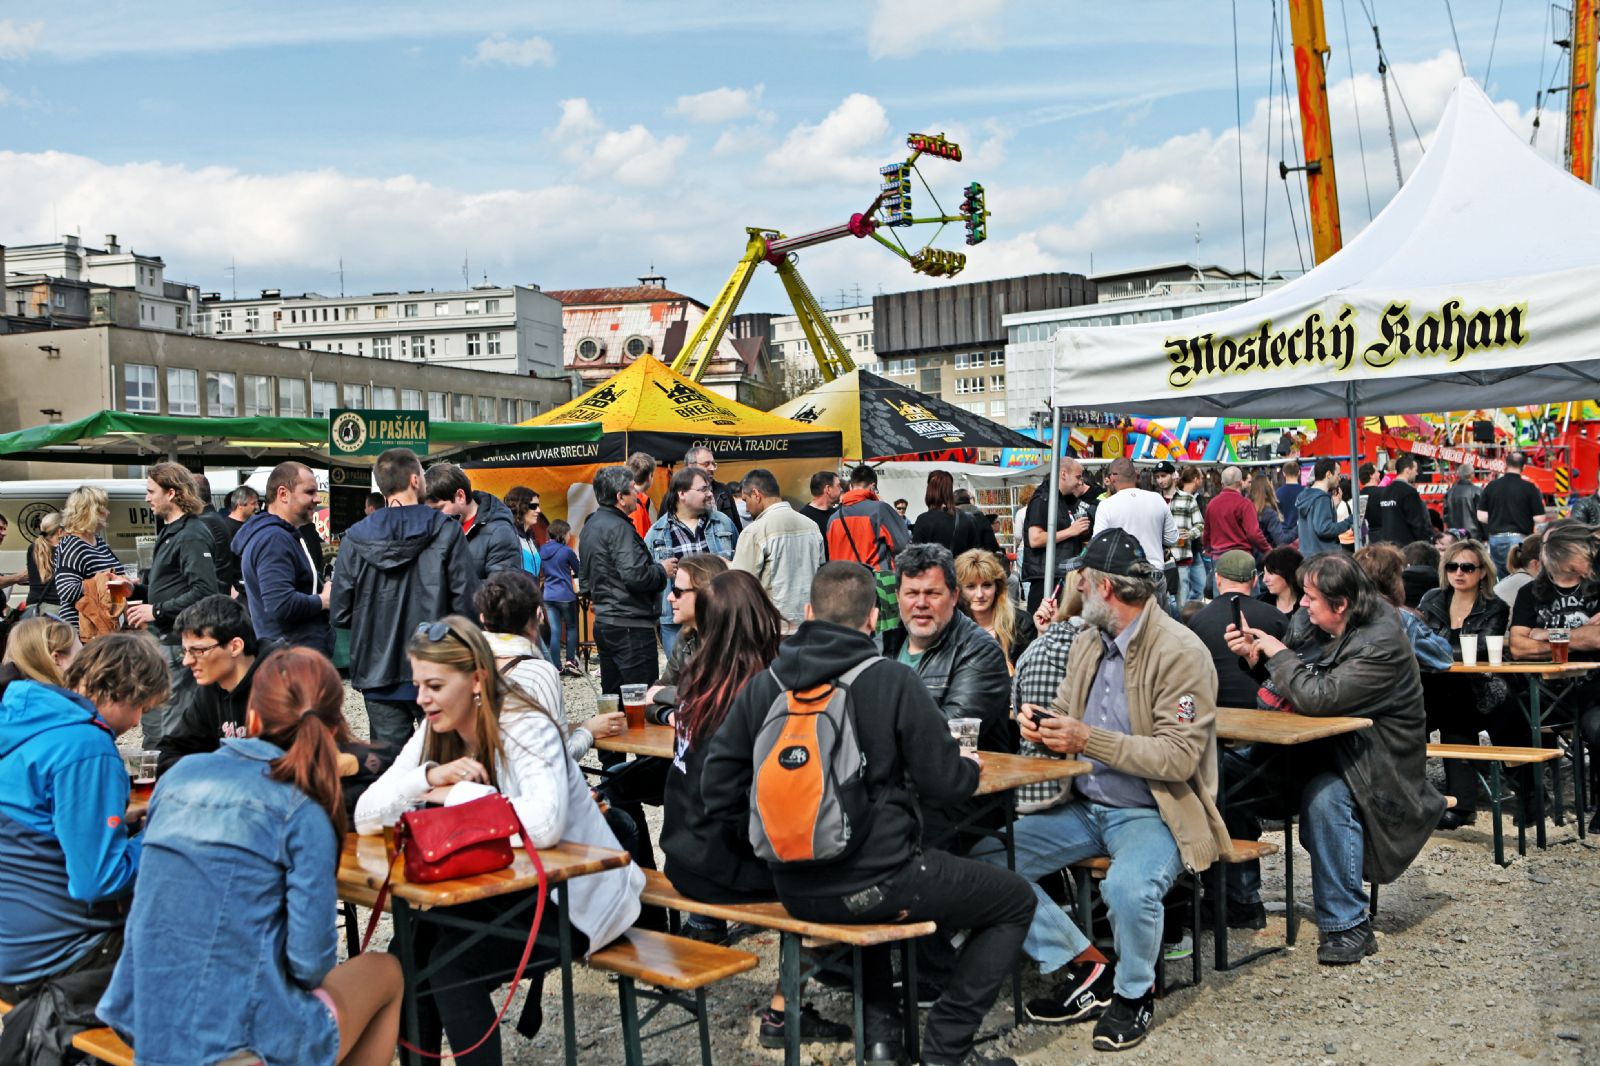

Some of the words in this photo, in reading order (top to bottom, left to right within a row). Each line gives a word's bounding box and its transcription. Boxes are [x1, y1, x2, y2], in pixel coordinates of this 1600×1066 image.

[1165, 308, 1355, 388] Mostecký
[1364, 301, 1525, 368] Kahan
[369, 420, 377, 439] U
[380, 416, 427, 439] PAŠÁKA
[745, 440, 789, 451] TRADICE
